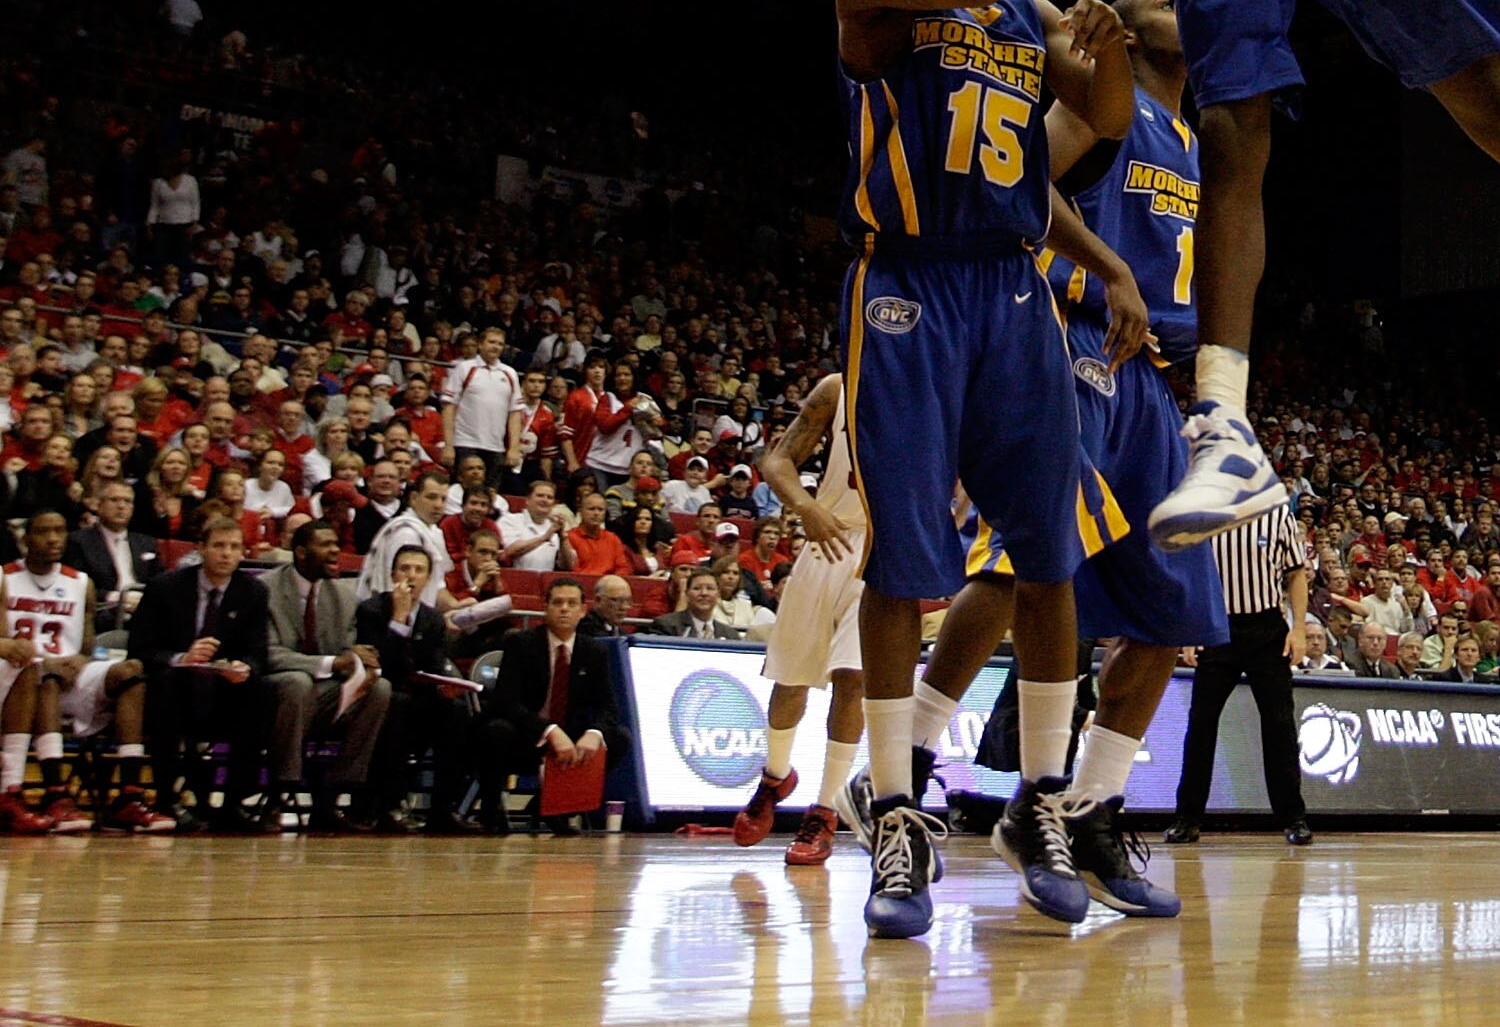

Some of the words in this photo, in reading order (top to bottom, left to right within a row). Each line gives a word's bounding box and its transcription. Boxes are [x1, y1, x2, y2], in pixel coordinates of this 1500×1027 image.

[944, 45, 1041, 98] STATE
[945, 79, 1033, 188] 15
[880, 307, 910, 323] OVC
